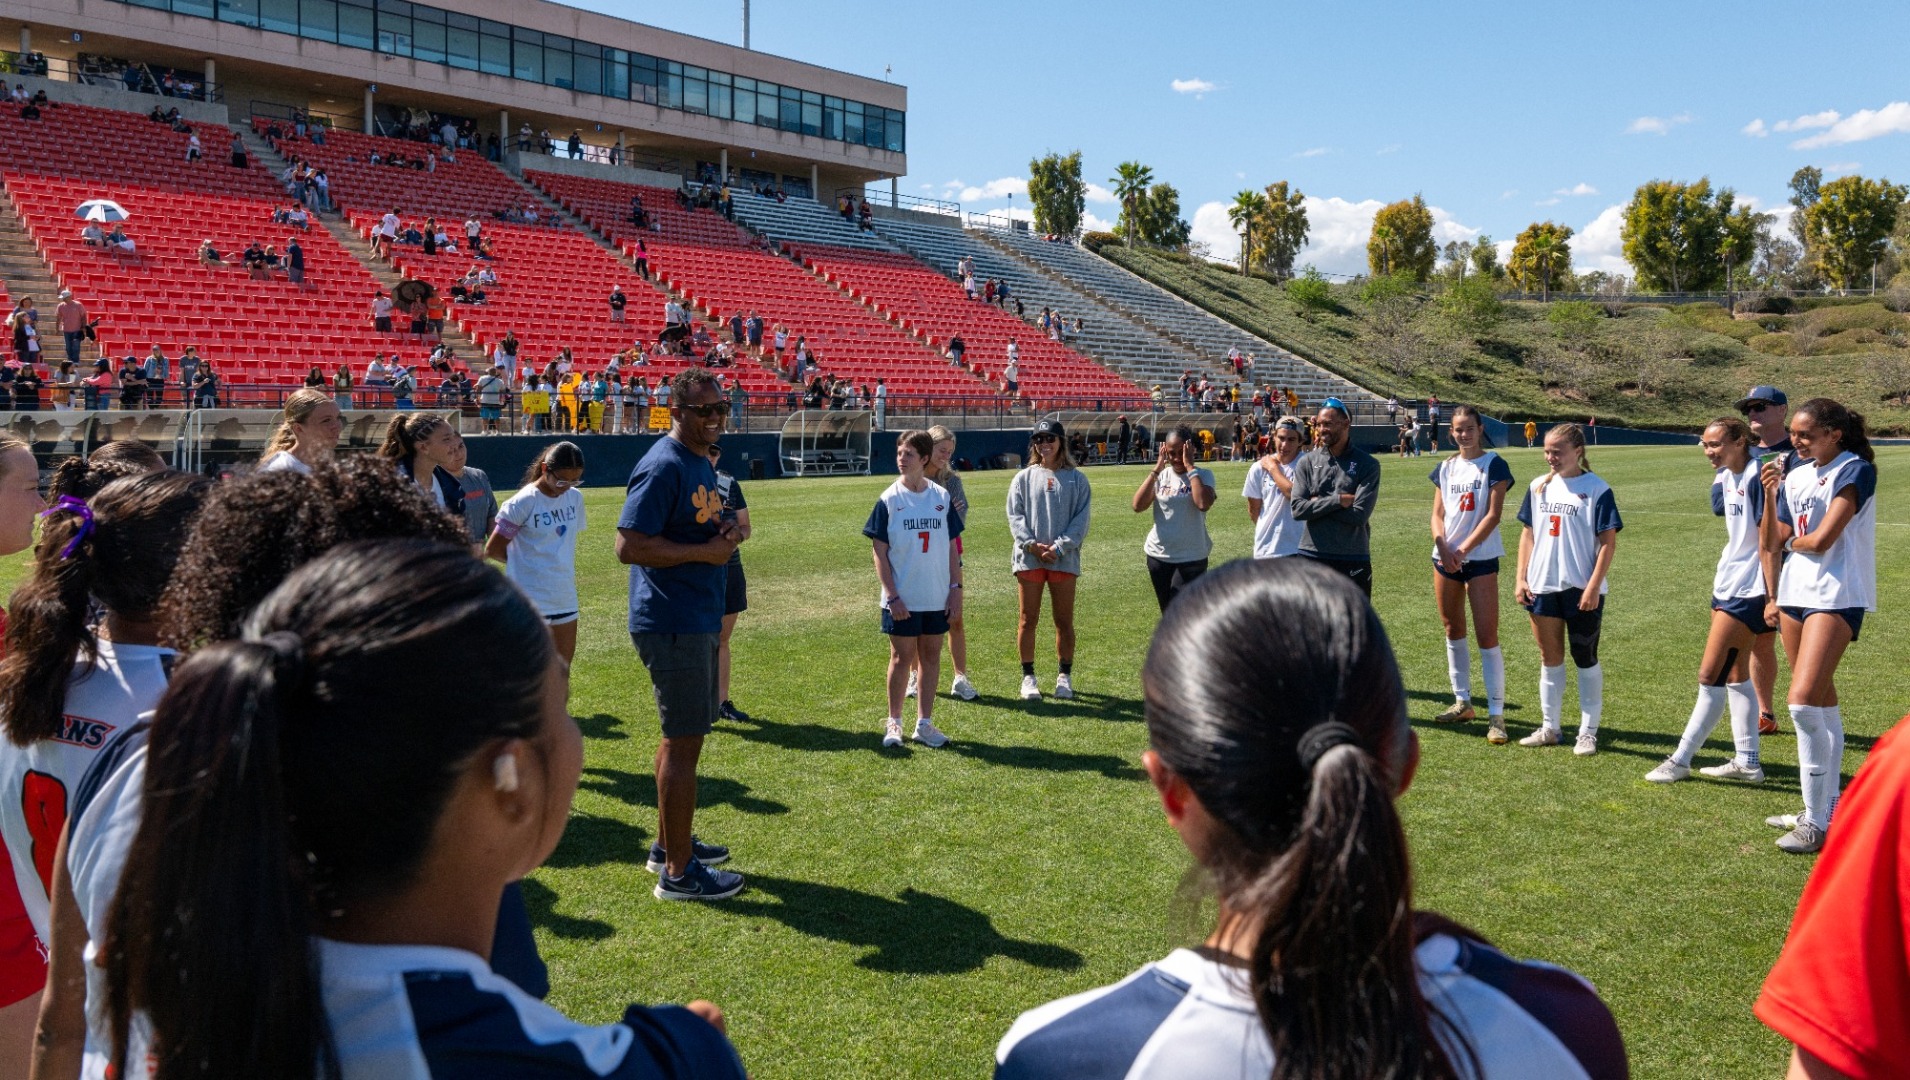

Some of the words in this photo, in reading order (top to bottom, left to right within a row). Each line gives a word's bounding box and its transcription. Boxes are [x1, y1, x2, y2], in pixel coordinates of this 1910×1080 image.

[903, 518, 942, 530] FULLERTON
[1549, 515, 1561, 537] 3
[918, 531, 930, 553] 7
